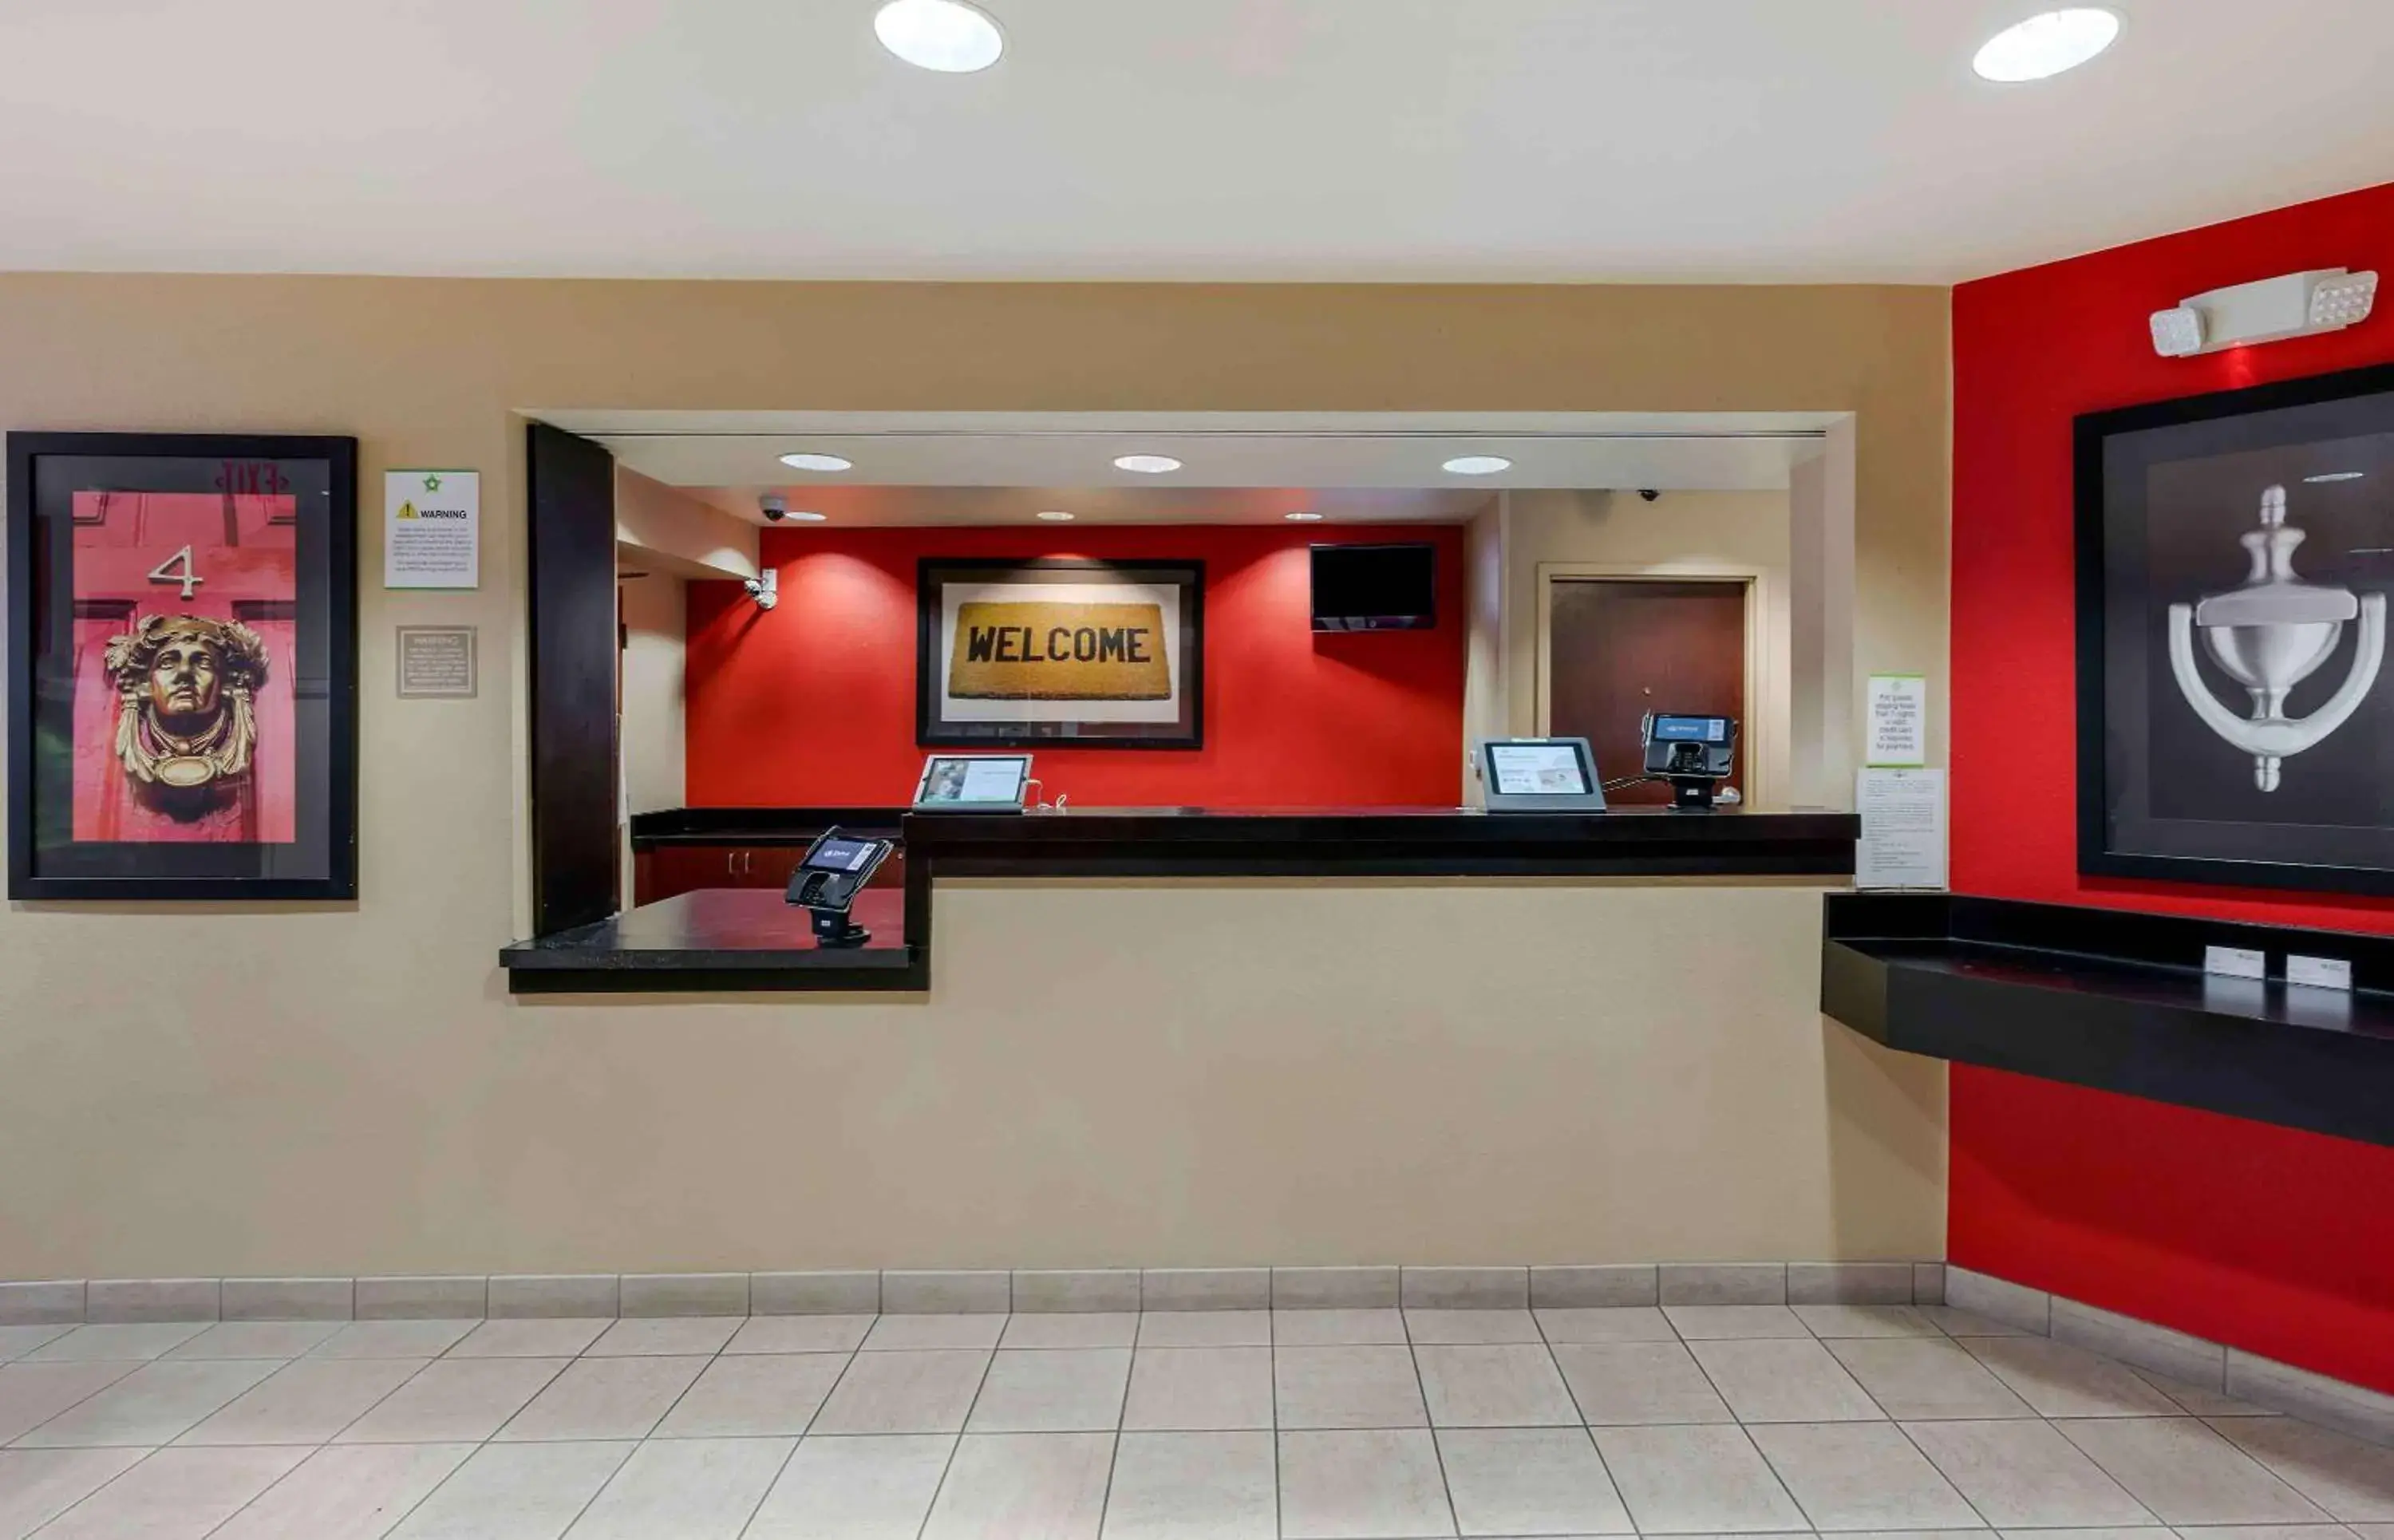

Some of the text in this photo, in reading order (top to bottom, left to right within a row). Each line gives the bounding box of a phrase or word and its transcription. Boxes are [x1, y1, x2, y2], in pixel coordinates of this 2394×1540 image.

[421, 510, 467, 519] WARNING
[147, 544, 203, 597] 4
[966, 626, 1151, 663] WELCOME
